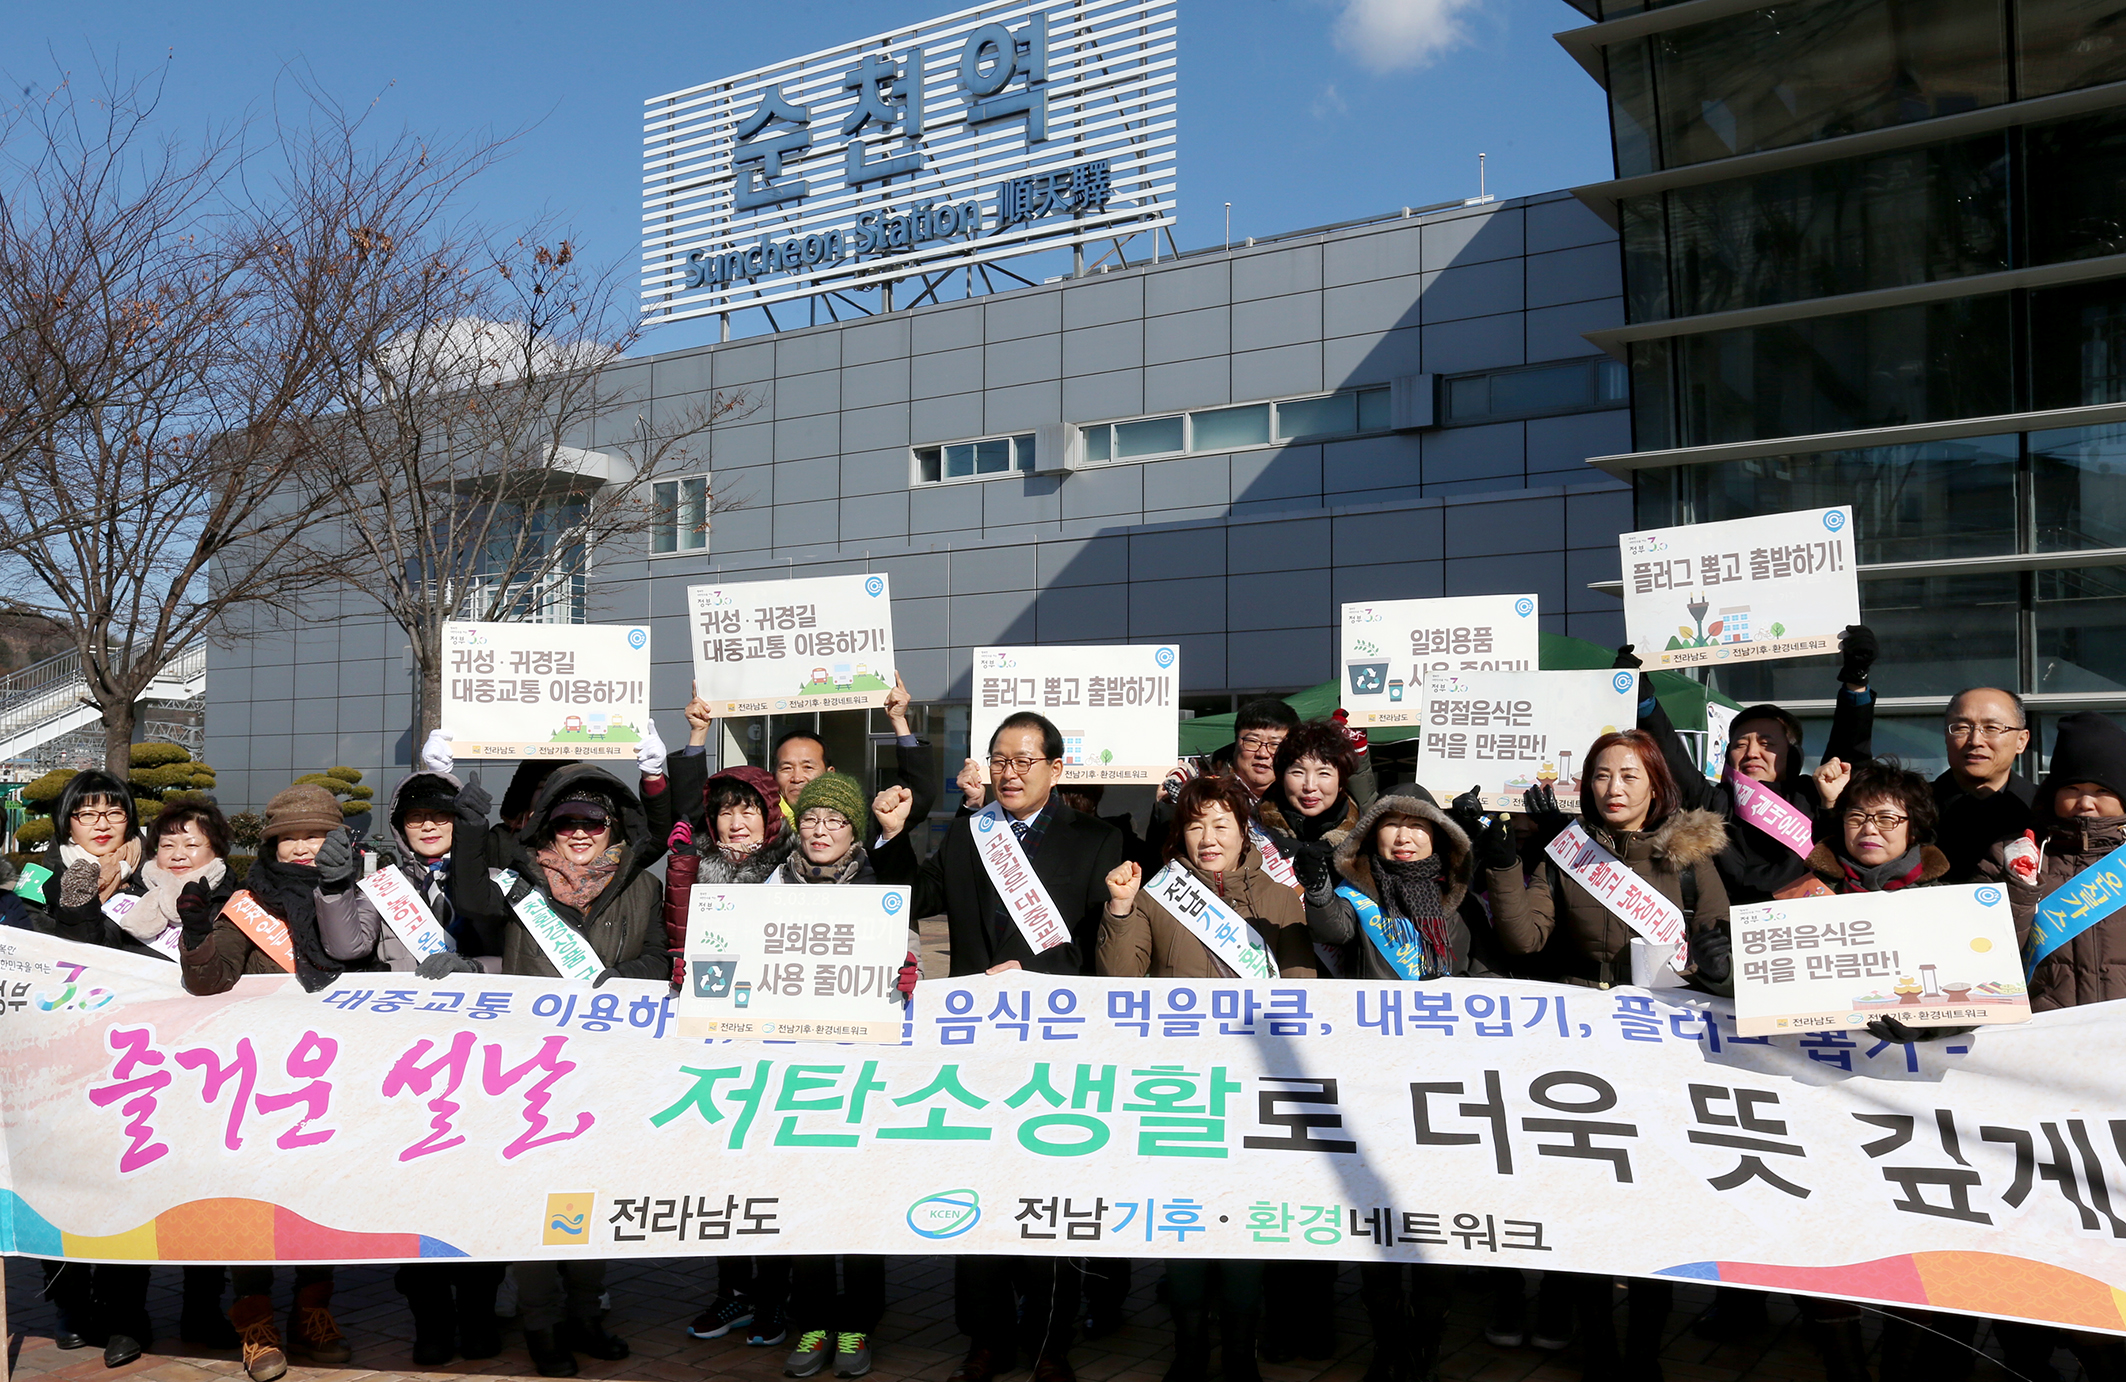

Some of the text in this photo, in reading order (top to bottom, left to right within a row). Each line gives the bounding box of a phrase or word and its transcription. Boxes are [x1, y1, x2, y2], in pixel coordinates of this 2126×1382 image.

[735, 12, 1049, 212] 순천역
[999, 158, 1111, 227] 順天驛
[684, 197, 982, 288] Suncheon Station
[1633, 539, 1844, 594] 플러그 뽑고 출발하기!
[703, 628, 886, 662] 대중교통 이용하기!
[1410, 626, 1493, 656] 일회용품
[1673, 652, 1708, 663] 전라남도
[452, 678, 643, 704] 대중교통 이용하기!
[738, 702, 768, 711] 전라남도
[982, 676, 1170, 707] 플러그 뽑고 출발하기!
[1378, 713, 1408, 722] 전라남도
[1430, 700, 1533, 726] 명절음식은
[484, 746, 516, 755] 전라남도
[1427, 733, 1546, 760] 먹을 만큼만!
[985, 833, 1028, 894] 고향길은
[387, 895, 427, 936] 높이고
[1588, 861, 1625, 899] 뽑고
[1616, 884, 1679, 943] 냉장고는
[2043, 871, 2123, 933] 온실가스
[764, 922, 855, 955] 일회용품
[1741, 920, 1875, 955] 명절음식은
[0, 960, 51, 975] 한민국을 여는
[757, 963, 893, 998] 사용 줄이기!
[1744, 950, 1901, 985] 먹을 만큼만!
[35, 961, 115, 1011] 3.0
[322, 990, 513, 1020] 대중교통
[531, 993, 675, 1040] 이용하
[936, 988, 1085, 1046] 음식은
[1107, 988, 1332, 1038] 먹을만큼,
[1356, 990, 1592, 1039] 내복입기,
[721, 1023, 753, 1032] 전라남도
[1792, 1016, 1836, 1027] 전라남도
[88, 1027, 337, 1172] 즐거운
[382, 1030, 595, 1160] 설날
[649, 1059, 1357, 1159] 저탄소생활로
[1410, 1070, 1639, 1184] 더욱
[1687, 1083, 1812, 1200] 뜻
[608, 1194, 781, 1242] 전라남도
[930, 1210, 960, 1219] KCEN
